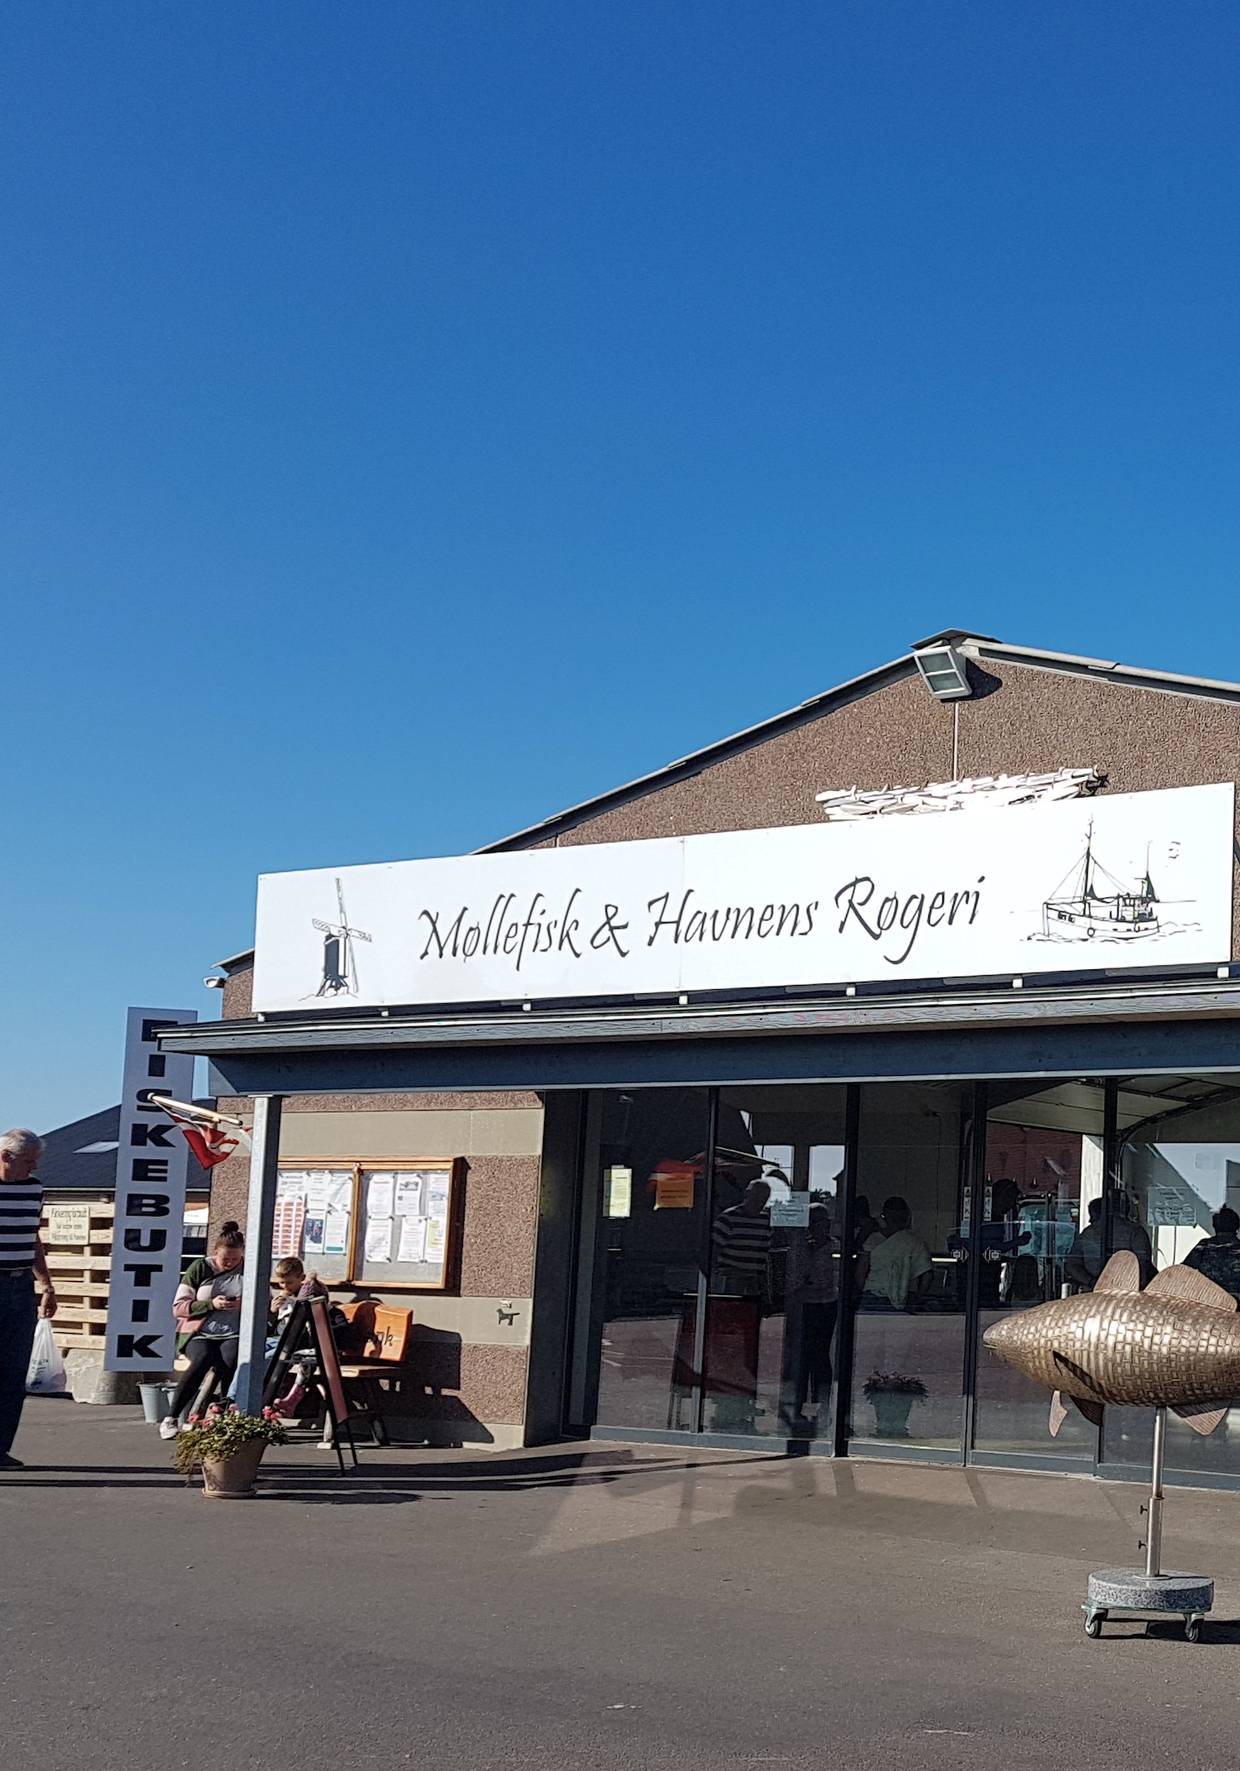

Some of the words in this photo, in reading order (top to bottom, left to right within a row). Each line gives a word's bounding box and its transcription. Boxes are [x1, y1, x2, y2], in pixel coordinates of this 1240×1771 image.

[419, 888, 582, 971] Møllefisk
[590, 904, 630, 958] &
[647, 888, 820, 947] Havnens
[835, 876, 986, 965] Røgeri
